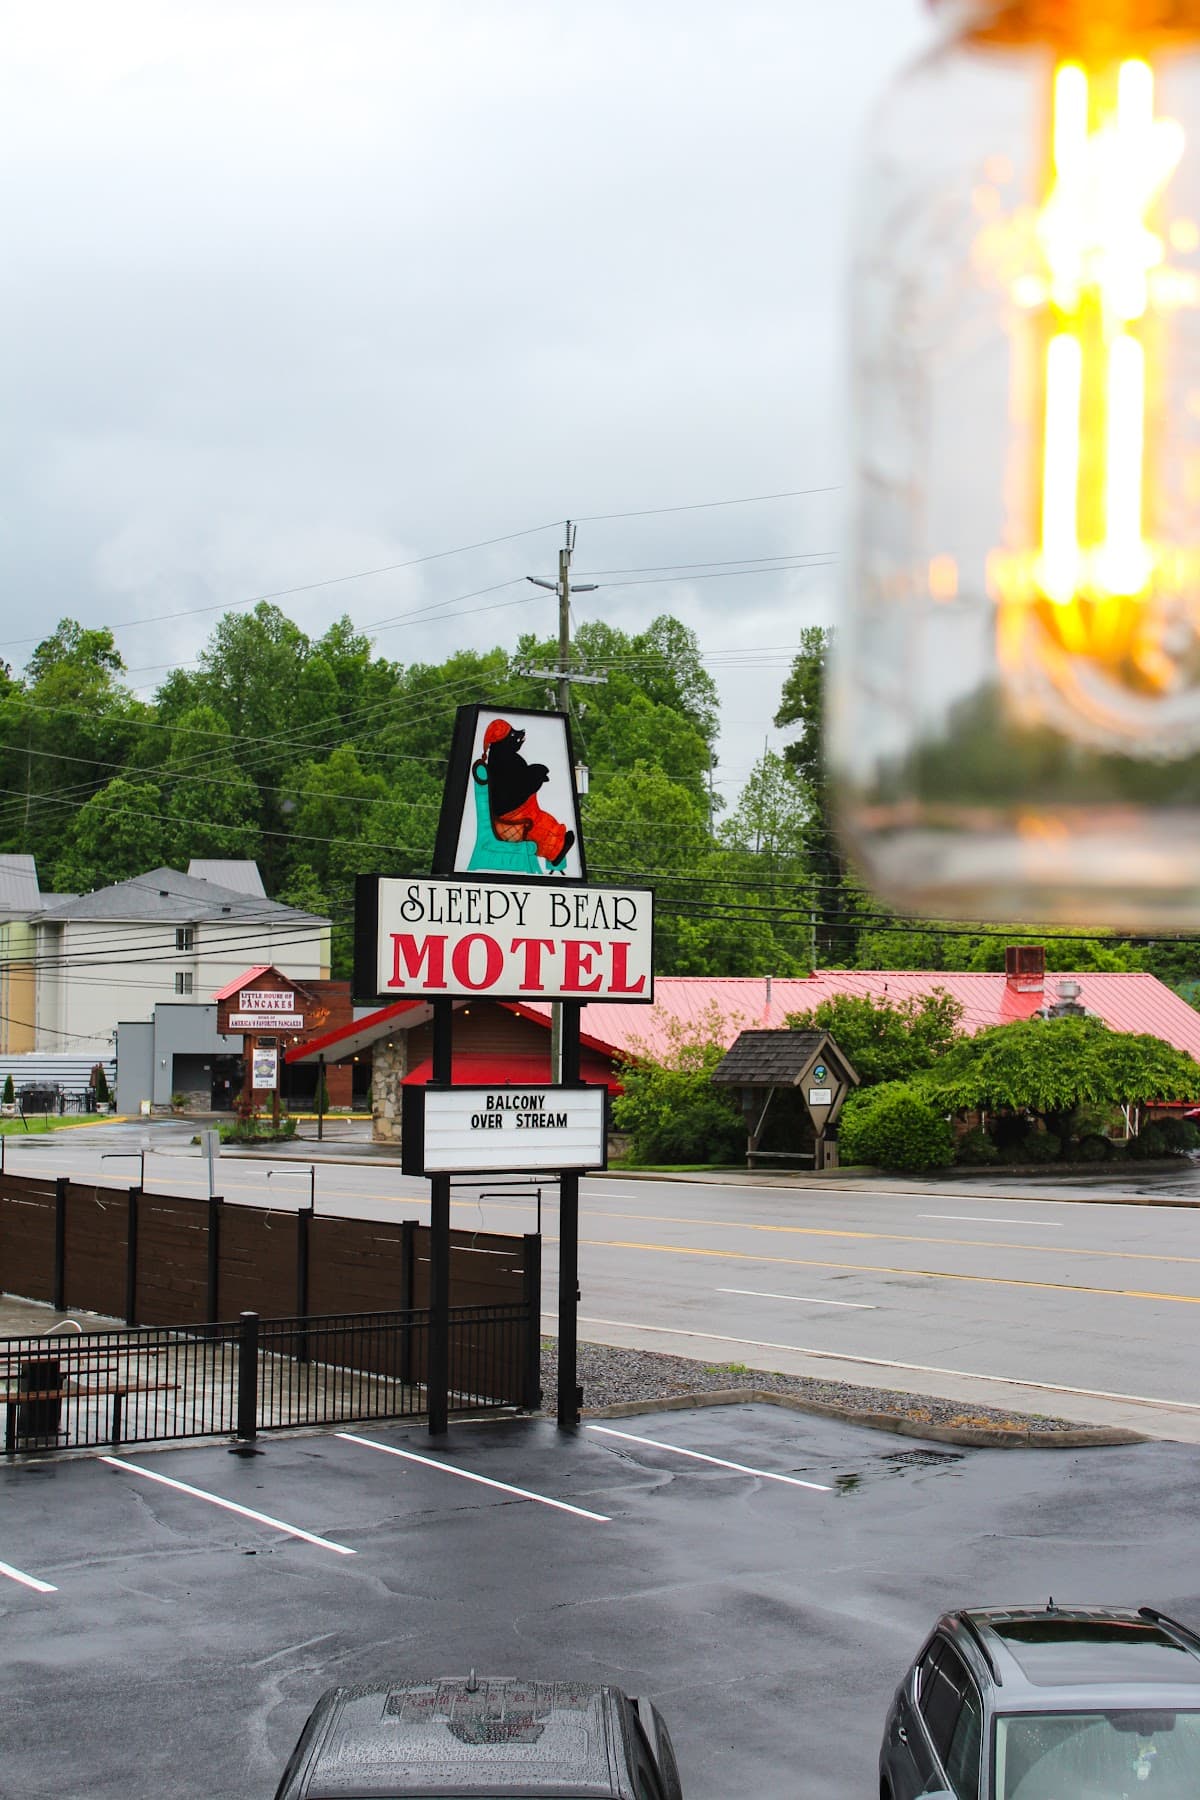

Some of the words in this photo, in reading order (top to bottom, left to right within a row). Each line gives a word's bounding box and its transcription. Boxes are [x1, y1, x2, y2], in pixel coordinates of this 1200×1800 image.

[400, 884, 530, 926] SLEEPY
[550, 893, 637, 931] BEAR
[387, 932, 646, 993] MOTEL
[241, 1000, 292, 1009] PANCAKES
[486, 1095, 545, 1110] BALCONY
[471, 1113, 503, 1129] OVER
[516, 1113, 568, 1128] STREAM
